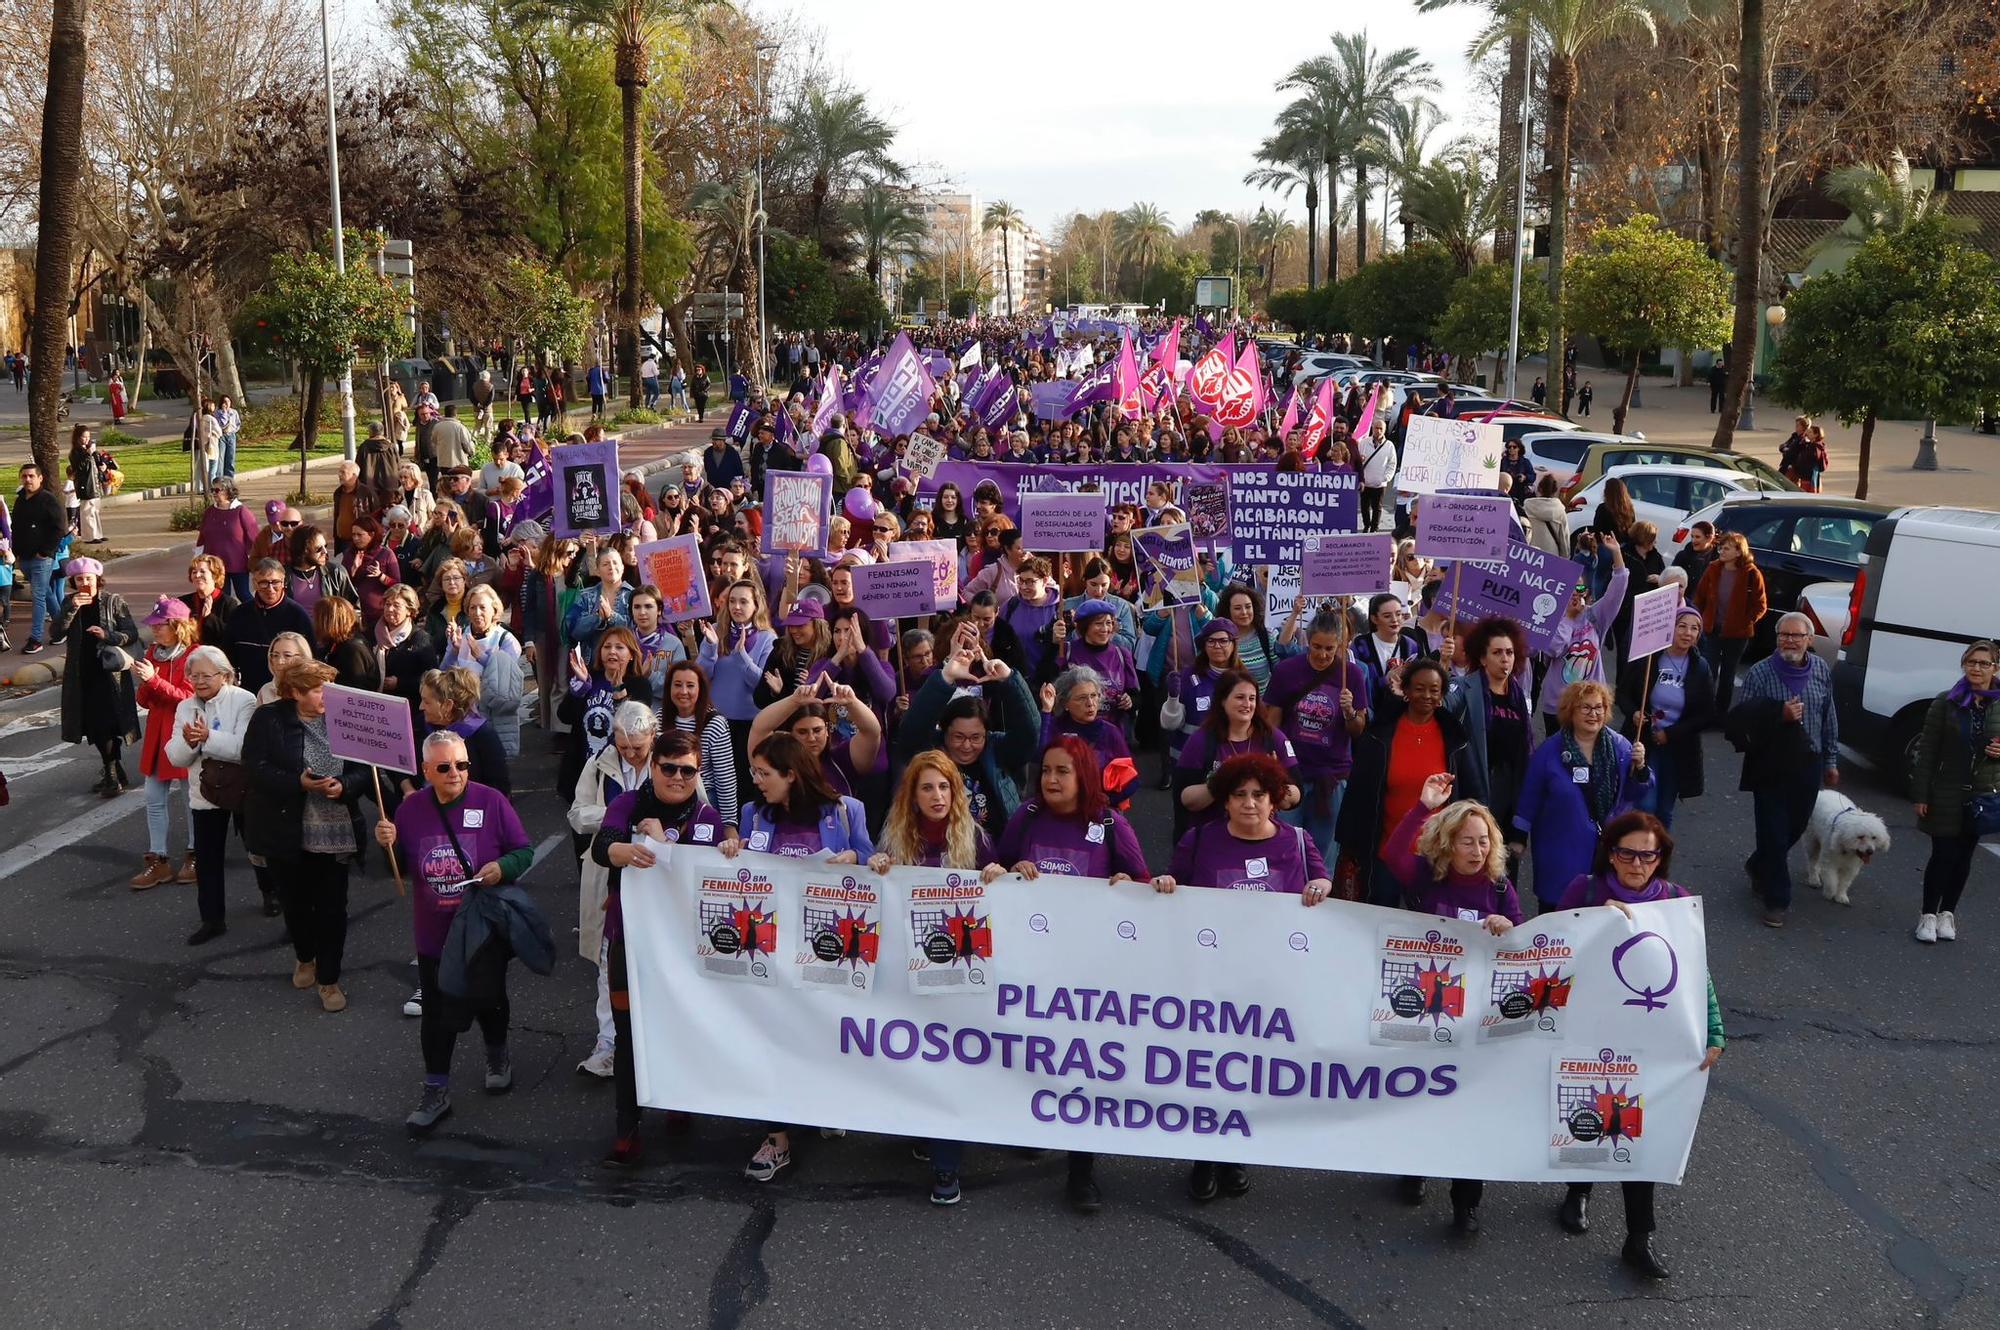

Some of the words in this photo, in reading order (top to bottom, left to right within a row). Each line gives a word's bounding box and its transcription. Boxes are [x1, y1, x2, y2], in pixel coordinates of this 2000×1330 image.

[1232, 472, 1268, 486] NOS
[1232, 489, 1290, 504] TANTO
[1302, 491, 1339, 507] QUE
[1432, 501, 1441, 509] LA
[1031, 508, 1071, 517] ABOLICIÓN
[1234, 508, 1324, 524] ACABARON
[1035, 520, 1092, 528] DESIGUALDADES
[1033, 530, 1091, 538] ESTRUCTURALES
[1474, 526, 1484, 534] DE
[1487, 527, 1496, 535] LA
[1245, 544, 1266, 559] EL
[1508, 544, 1545, 569] UNA
[1159, 552, 1193, 570] SIEMPRE
[867, 567, 919, 579] FEMINISMO
[870, 582, 884, 590] SIN
[1519, 570, 1567, 596] NACE
[1481, 579, 1520, 604] PUTA
[347, 697, 355, 706] EL
[358, 699, 385, 711] SUJETO
[377, 716, 390, 726] DEL
[334, 718, 375, 734] FEMINISMO
[377, 729, 402, 741] SOMOS
[342, 732, 356, 741] LAS
[357, 736, 388, 749] MUJERES
[432, 848, 458, 858] SOMO
[780, 847, 808, 856] SOMOS
[1040, 860, 1071, 872] SOMOS
[753, 875, 767, 883] 8M
[702, 880, 773, 892] FEMINISMO
[857, 883, 871, 891] 8M
[1232, 882, 1266, 891] SOMOS
[805, 886, 876, 902] FEMINISMO
[911, 887, 984, 898] FEMINISMO
[1385, 938, 1464, 954] FEMINISMO
[1442, 937, 1458, 945] 8M
[1550, 938, 1565, 946] 8M
[1495, 947, 1571, 959] FEMINISMO
[997, 984, 1296, 1042] PLATAFORMA
[840, 1018, 1126, 1083] NOSOTRAS
[1146, 1046, 1458, 1099] DECIDIMOS
[1560, 1061, 1638, 1073] FEMINISMO
[1032, 1088, 1251, 1136] CÓRDOBA
